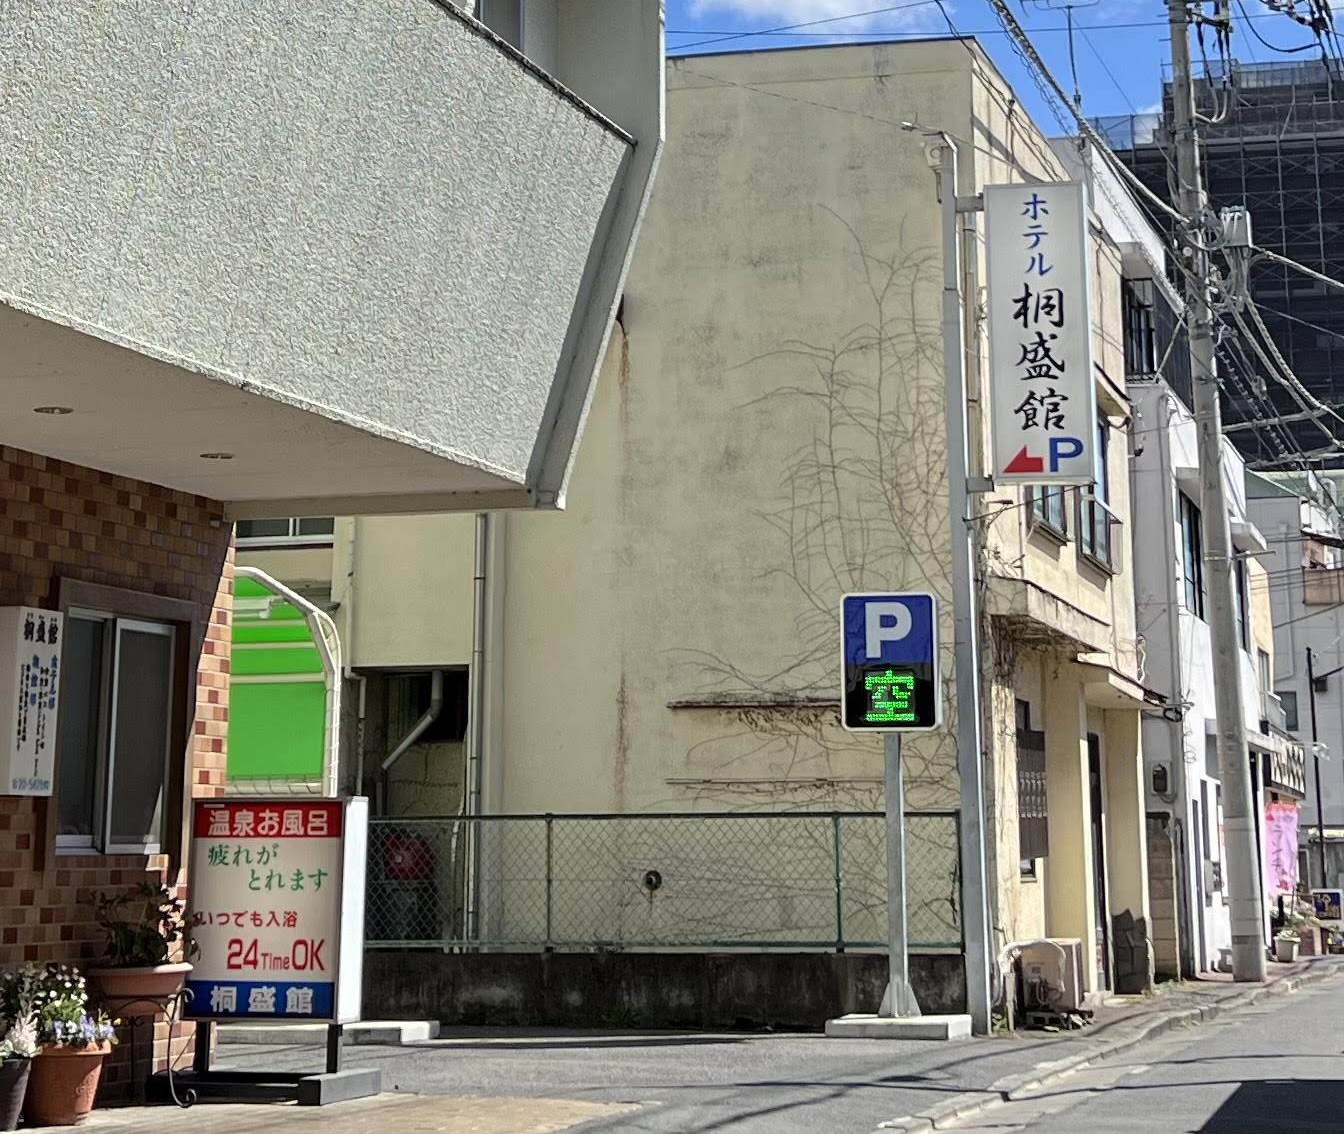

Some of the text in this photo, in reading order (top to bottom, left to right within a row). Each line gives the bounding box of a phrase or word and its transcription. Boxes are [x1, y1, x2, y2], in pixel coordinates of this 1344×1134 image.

[1012, 193, 1069, 431] ホテル 桐盛館
[1049, 436, 1084, 472] P
[865, 601, 912, 658] P
[864, 669, 915, 722] 空
[208, 809, 328, 836] 温泉お風呂
[208, 843, 280, 866] 疲れが
[248, 868, 329, 892] とれます
[199, 910, 298, 928] いつでも入浴
[227, 938, 259, 970] 24
[292, 938, 325, 971] OK
[210, 985, 314, 1014] 桐盛館
